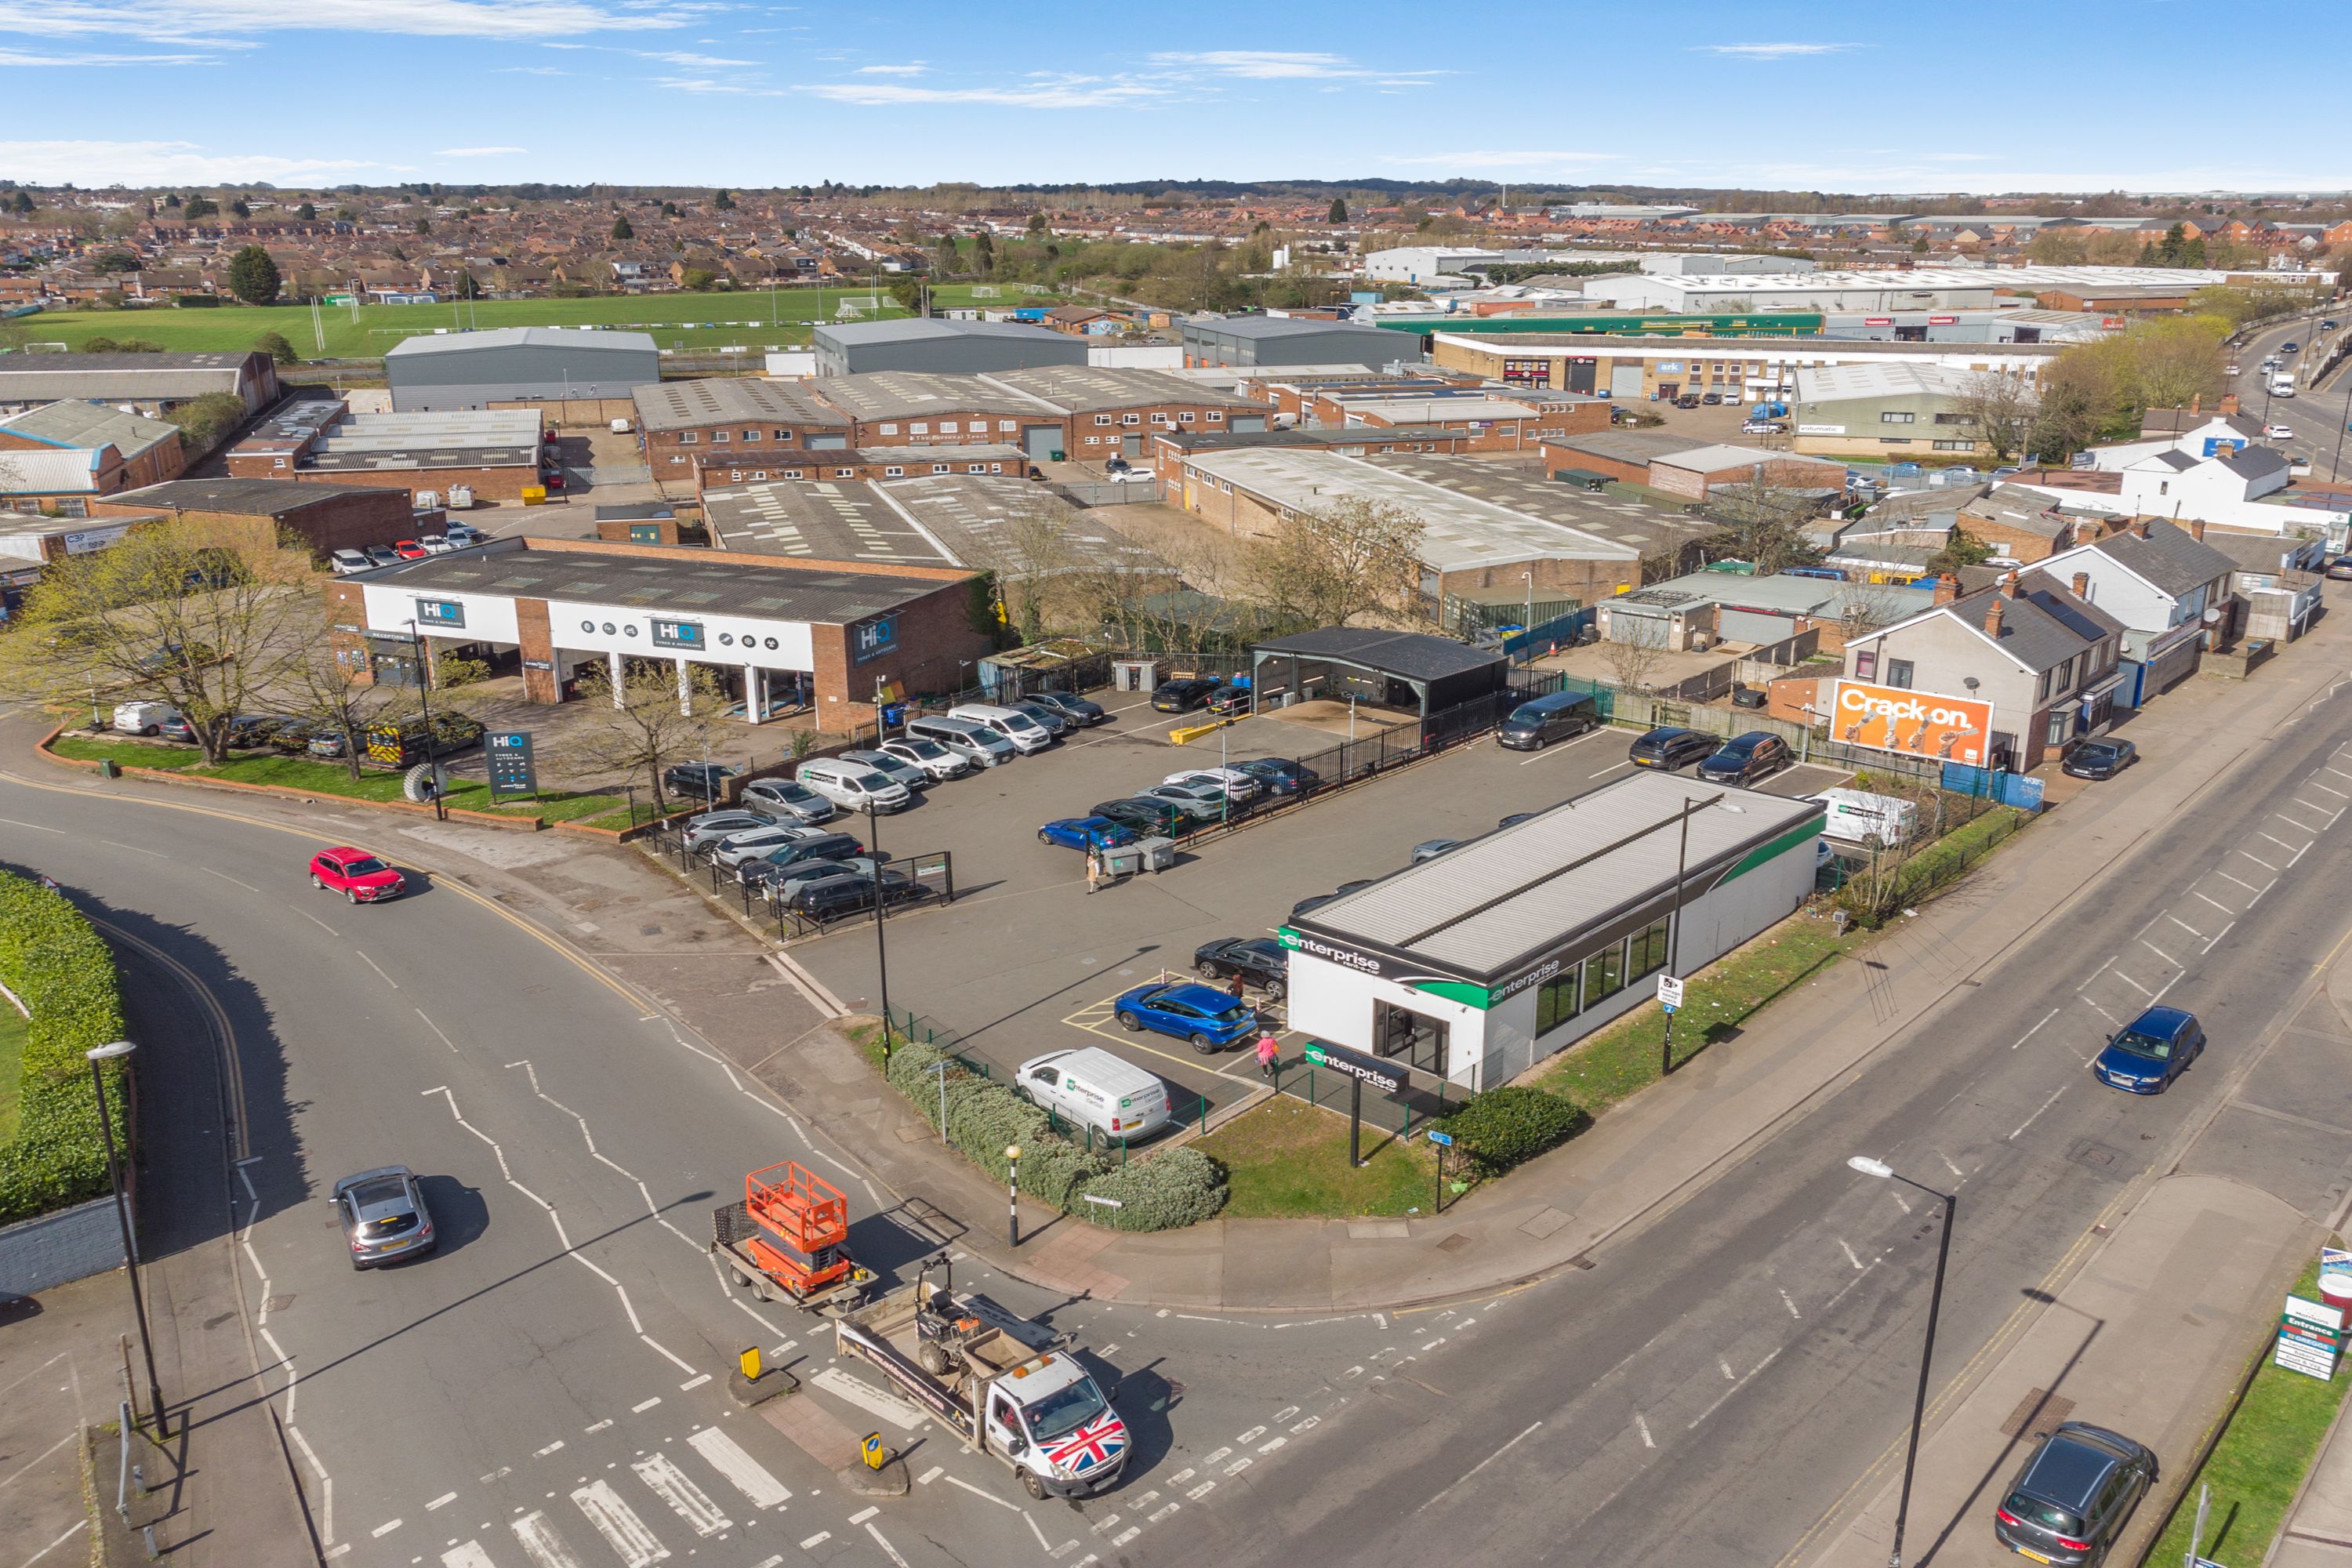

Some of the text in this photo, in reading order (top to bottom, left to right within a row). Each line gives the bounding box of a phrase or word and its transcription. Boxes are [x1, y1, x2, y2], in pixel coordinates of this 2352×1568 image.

[423, 602, 456, 619] HiQ
[660, 623, 695, 641] HiQ
[861, 622, 890, 649] HiQ
[1842, 688, 1973, 728] Crack on.
[492, 735, 523, 747] HiQ
[1279, 933, 1380, 971] enterprise
[1343, 960, 1380, 975] rent-a-car
[1488, 960, 1559, 1001] enterprise
[1306, 1051, 1397, 1088] enterprise
[1067, 1081, 1105, 1102] enterprise
[1363, 1078, 1396, 1092] rent-a-car
[1121, 1088, 1160, 1106] enterprise
[2288, 1317, 2333, 1336] Entrance
[2296, 1311, 2329, 1325] Morrisons
[2295, 1336, 2328, 1350] GREGGS
[2294, 1350, 2316, 1360] Bakery
[2306, 1368, 2321, 1377] Wine
[2310, 1362, 2321, 1370] Veg
